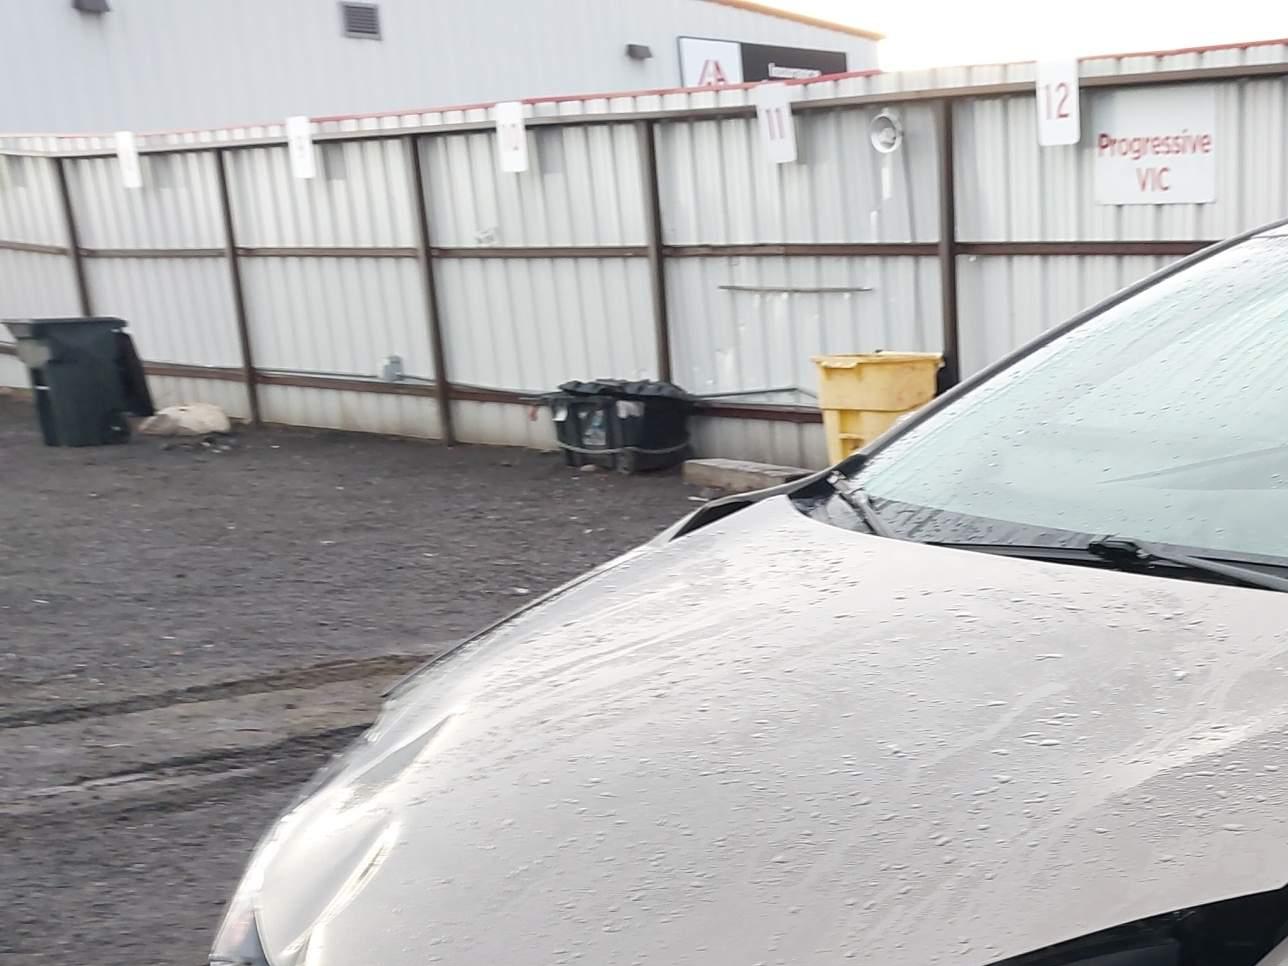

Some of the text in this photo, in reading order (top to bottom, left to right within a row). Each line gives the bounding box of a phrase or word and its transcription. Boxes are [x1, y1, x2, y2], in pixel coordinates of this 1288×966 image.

[1045, 82, 1070, 120] 12
[765, 107, 785, 139] 11
[1098, 128, 1212, 160] Progressive
[1136, 167, 1170, 192] VIC
